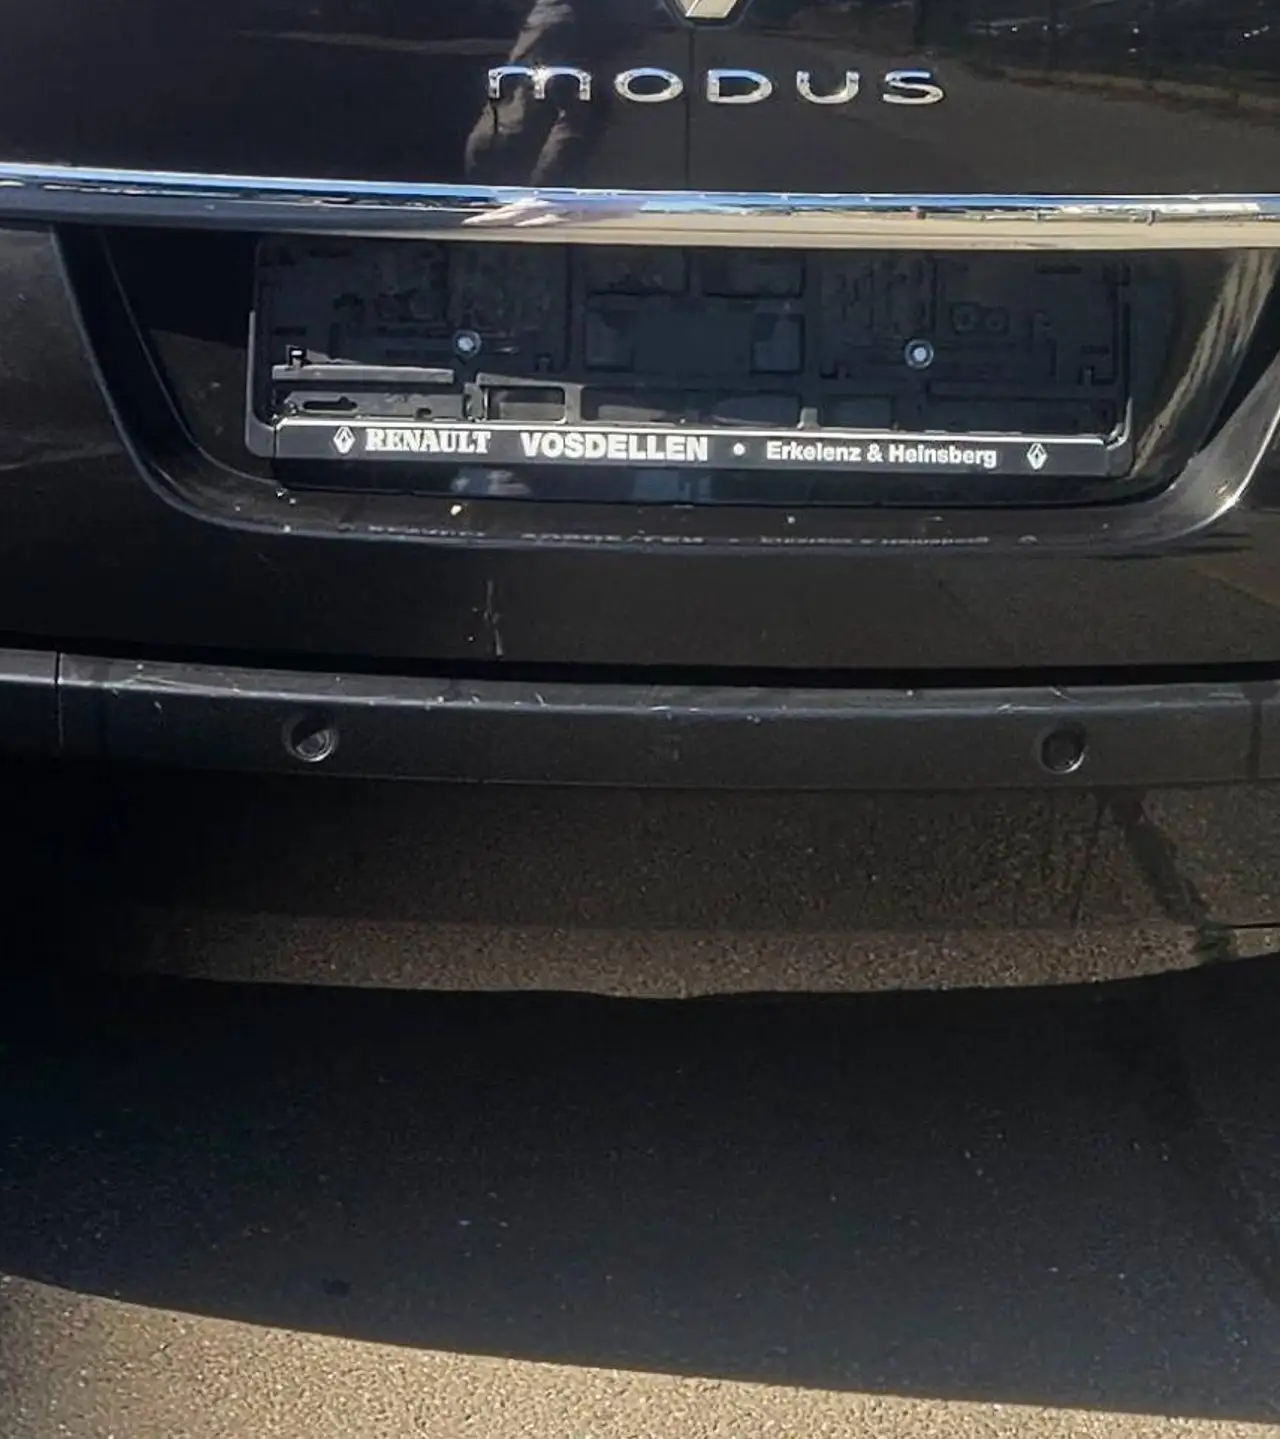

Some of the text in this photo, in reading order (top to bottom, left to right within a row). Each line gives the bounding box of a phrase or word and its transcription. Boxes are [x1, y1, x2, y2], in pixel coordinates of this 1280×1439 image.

[365, 427, 998, 468] RENAULT VOSDELLEN Erkelenz & Heinsberg
